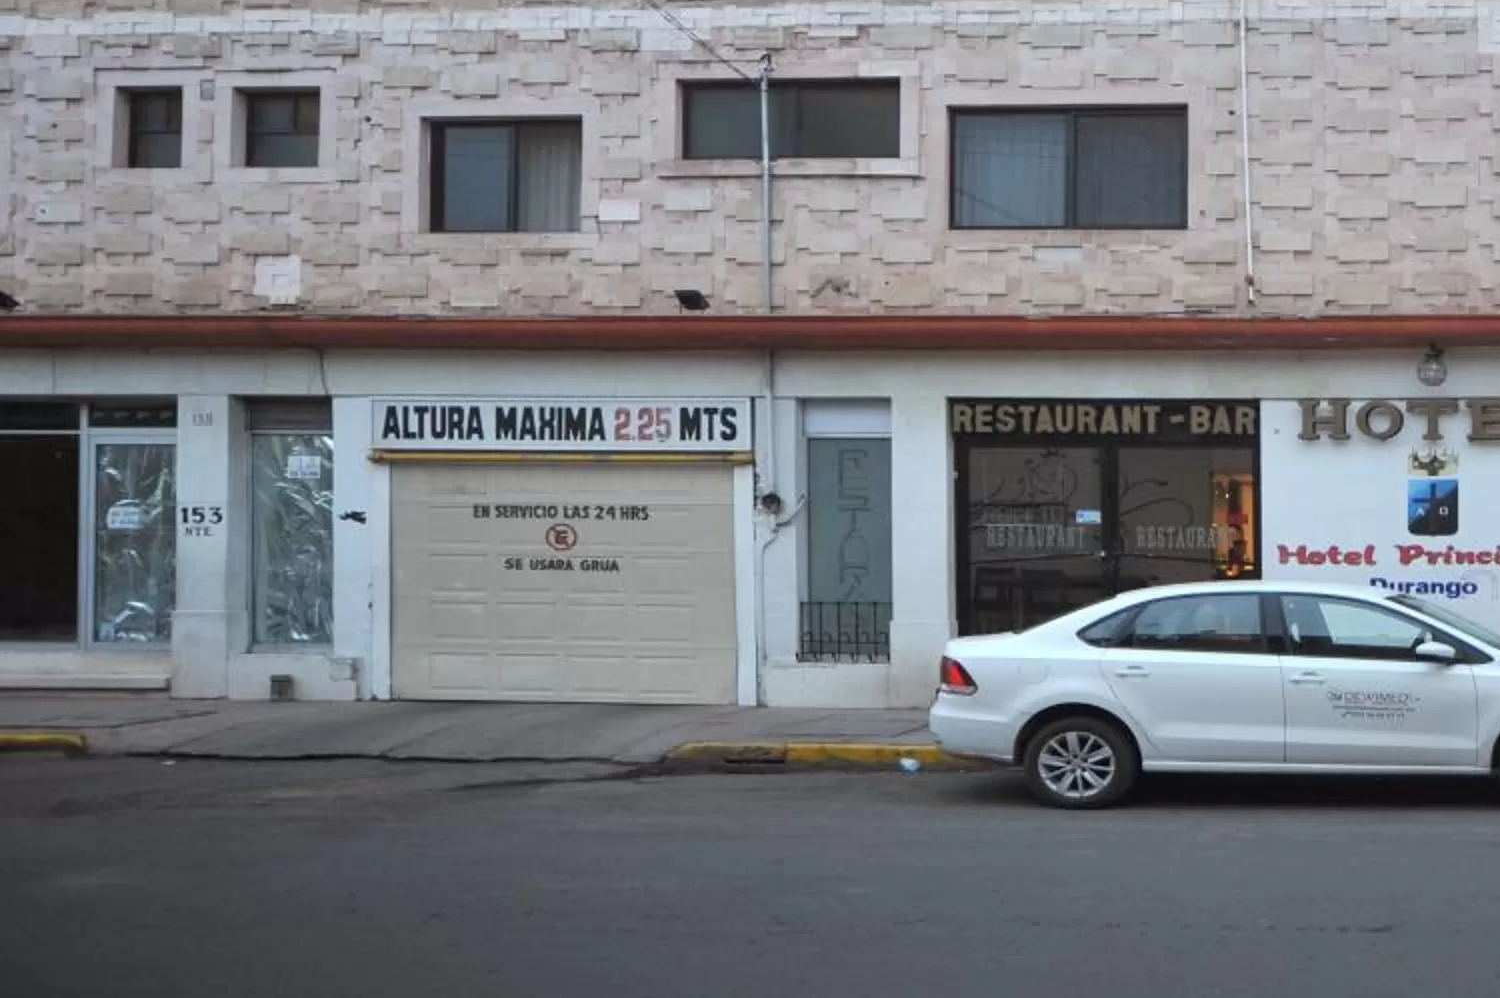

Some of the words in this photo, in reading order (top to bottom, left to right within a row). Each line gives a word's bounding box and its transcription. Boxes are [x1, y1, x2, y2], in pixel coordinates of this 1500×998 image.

[382, 405, 484, 440] ALTURA
[495, 406, 606, 441] MAXIMA
[614, 407, 672, 442] 2.25
[679, 407, 737, 441] MTS
[953, 405, 1161, 434] RESTAURANT
[1189, 406, 1256, 435] BAR
[180, 506, 223, 524] 153
[472, 505, 490, 519] EN
[495, 505, 558, 519] SERVICIO
[563, 505, 590, 519] LAS
[594, 506, 616, 520] 24
[620, 506, 649, 521] HRS
[504, 558, 523, 570] SE
[530, 559, 574, 571] USARA
[580, 559, 620, 572] GRUA
[1277, 544, 1377, 566] Hotel
